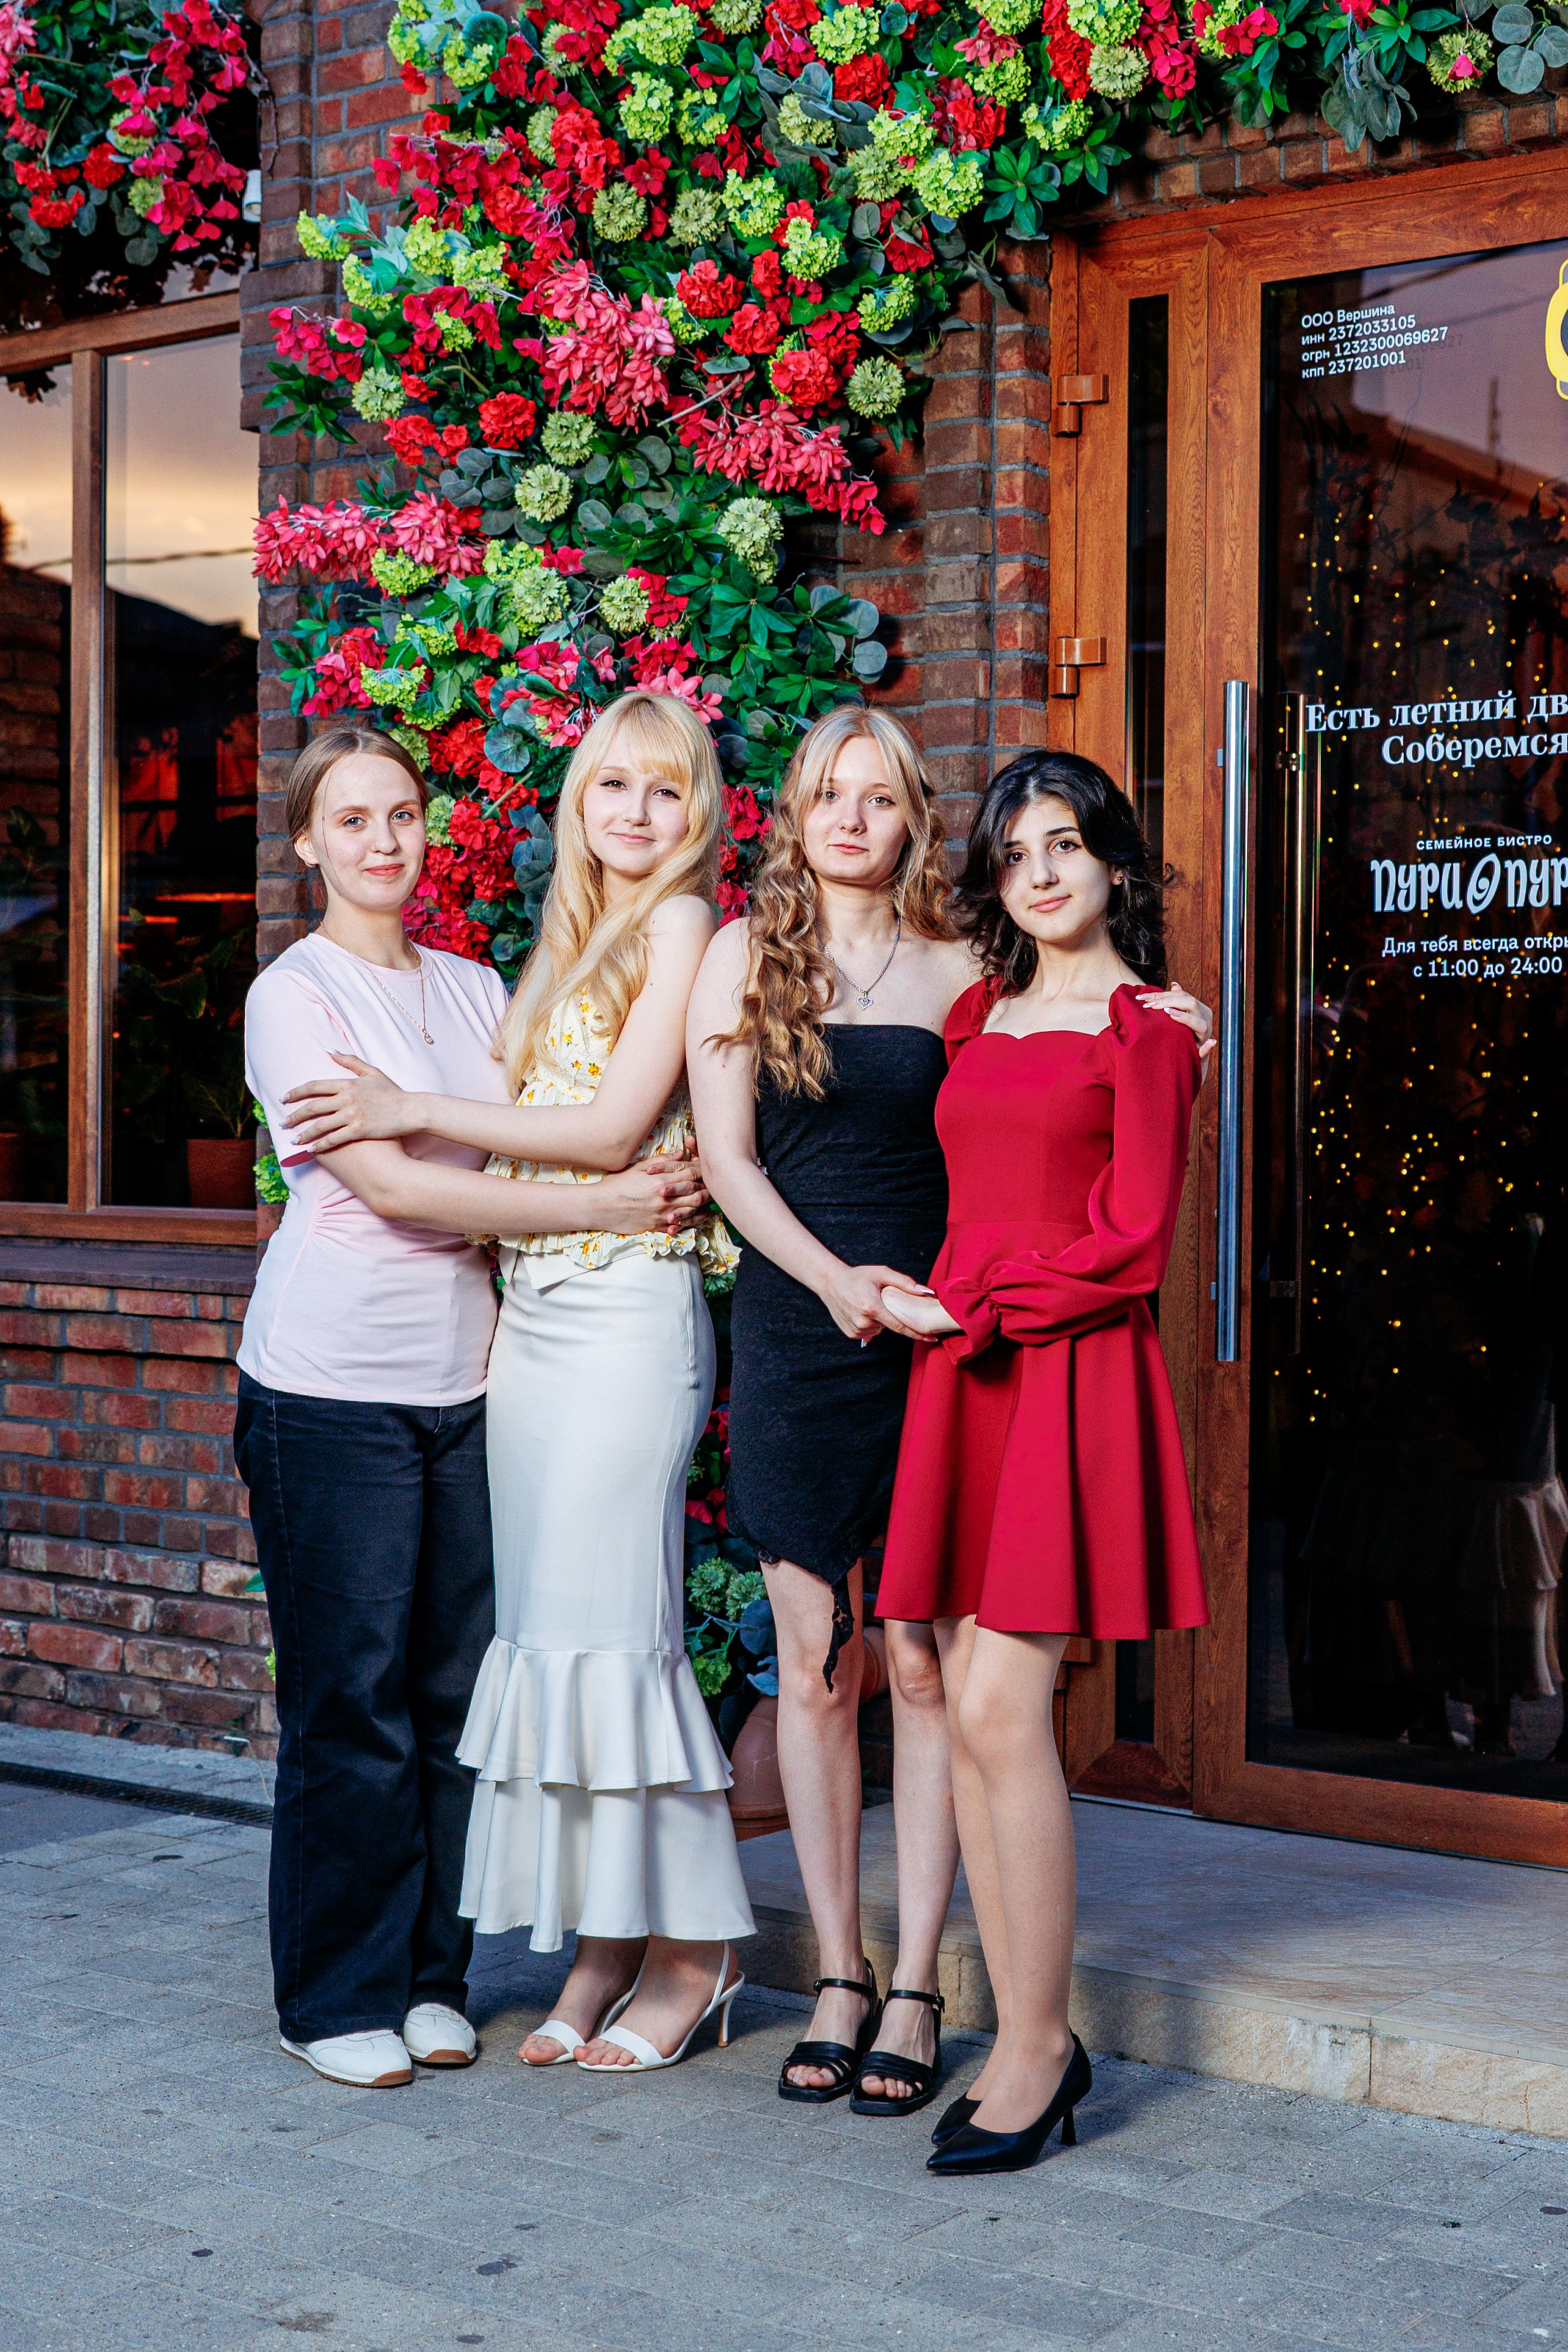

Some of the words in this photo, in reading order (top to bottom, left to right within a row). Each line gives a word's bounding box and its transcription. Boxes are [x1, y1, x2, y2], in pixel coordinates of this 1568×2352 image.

[1302, 311, 1333, 329] ООО
[1337, 305, 1395, 323] Вершина
[1302, 333, 1325, 345] инн
[1329, 315, 1416, 342] 2372033105
[1302, 349, 1330, 363] огрн
[1335, 326, 1449, 358] 1232300069627
[1302, 367, 1324, 379] кпп
[1329, 350, 1406, 375] 237201001
[1305, 704, 1380, 732] Есть
[1389, 690, 1517, 726] летний
[1382, 733, 1568, 768] Соберемся
[1416, 836, 1491, 850] СЕМЕЙНОЕ
[1498, 835, 1552, 846] БИСТРО
[1382, 937, 1415, 957] Для
[1420, 935, 1458, 952] тебя
[1464, 938, 1519, 952] всегда
[1414, 966, 1422, 977] с
[1428, 959, 1479, 976] 11:00
[1483, 963, 1505, 978] до
[1510, 956, 1562, 974] 24:00
